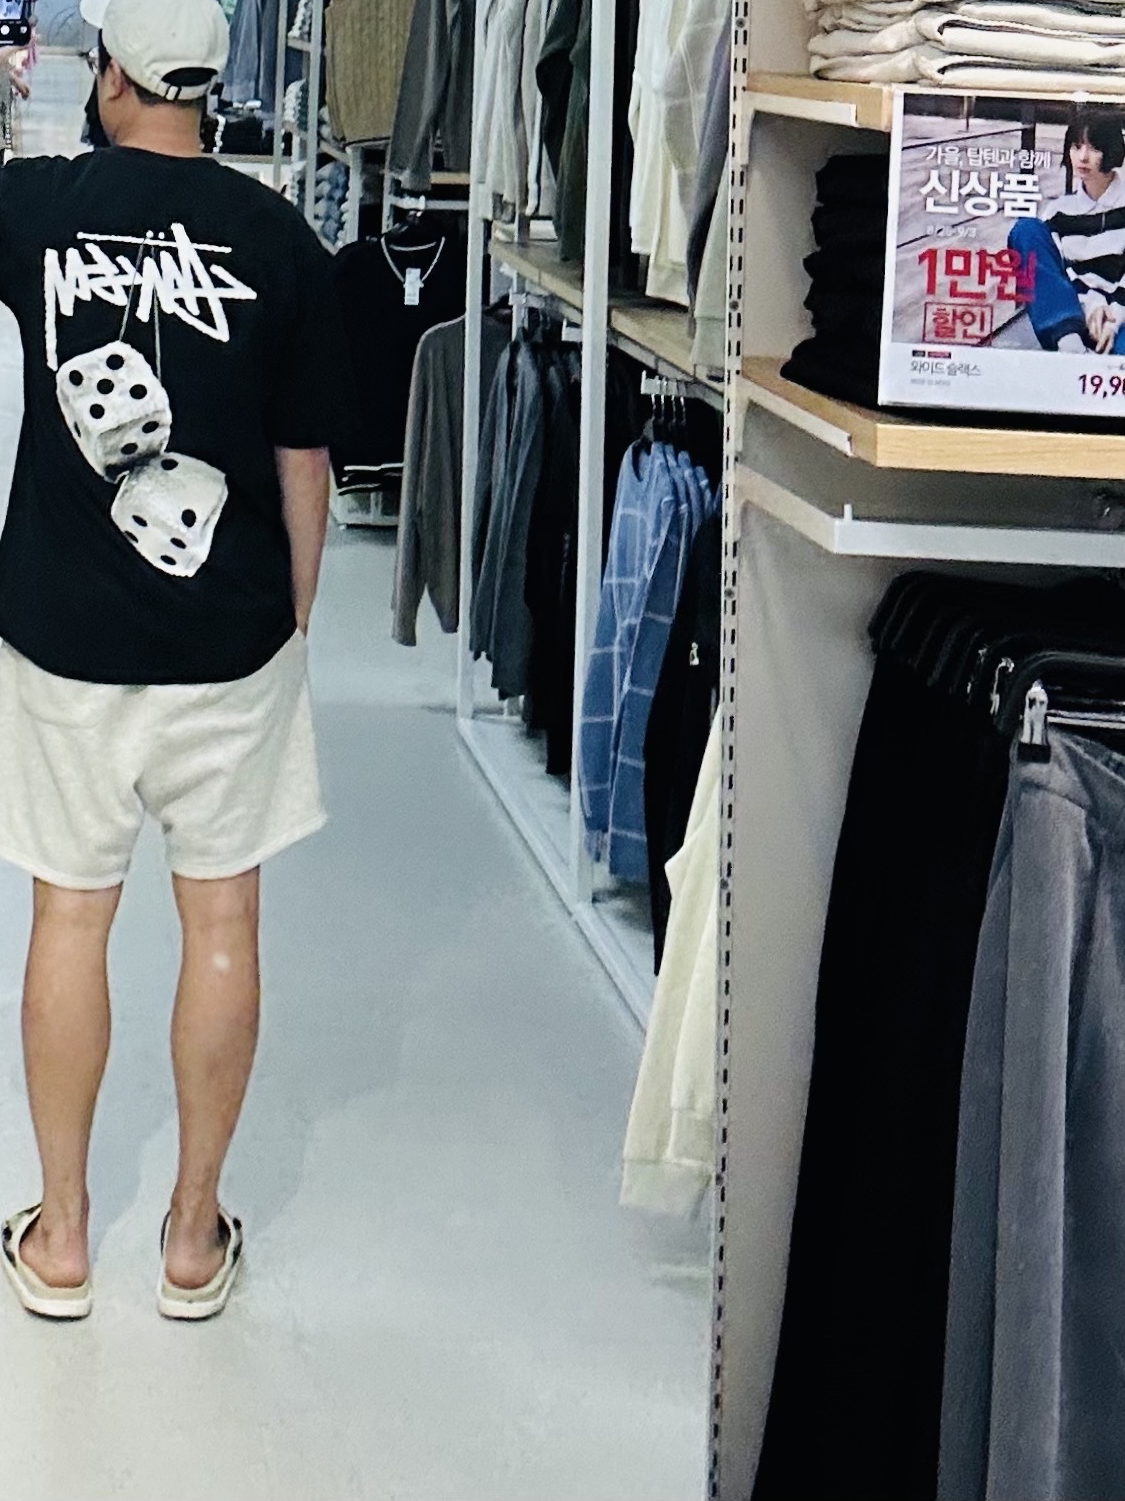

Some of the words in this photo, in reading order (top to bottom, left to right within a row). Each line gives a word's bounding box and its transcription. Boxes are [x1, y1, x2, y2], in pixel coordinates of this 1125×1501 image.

[967, 147, 1016, 168] 탑텐과
[1018, 149, 1051, 169] 함께
[919, 169, 1043, 218] 신상품
[918, 248, 1037, 303] 1만원
[932, 307, 987, 339] 할인
[910, 360, 945, 375] 와이드
[946, 363, 982, 377] 슬랙스
[1078, 374, 1125, 399] 19,9
